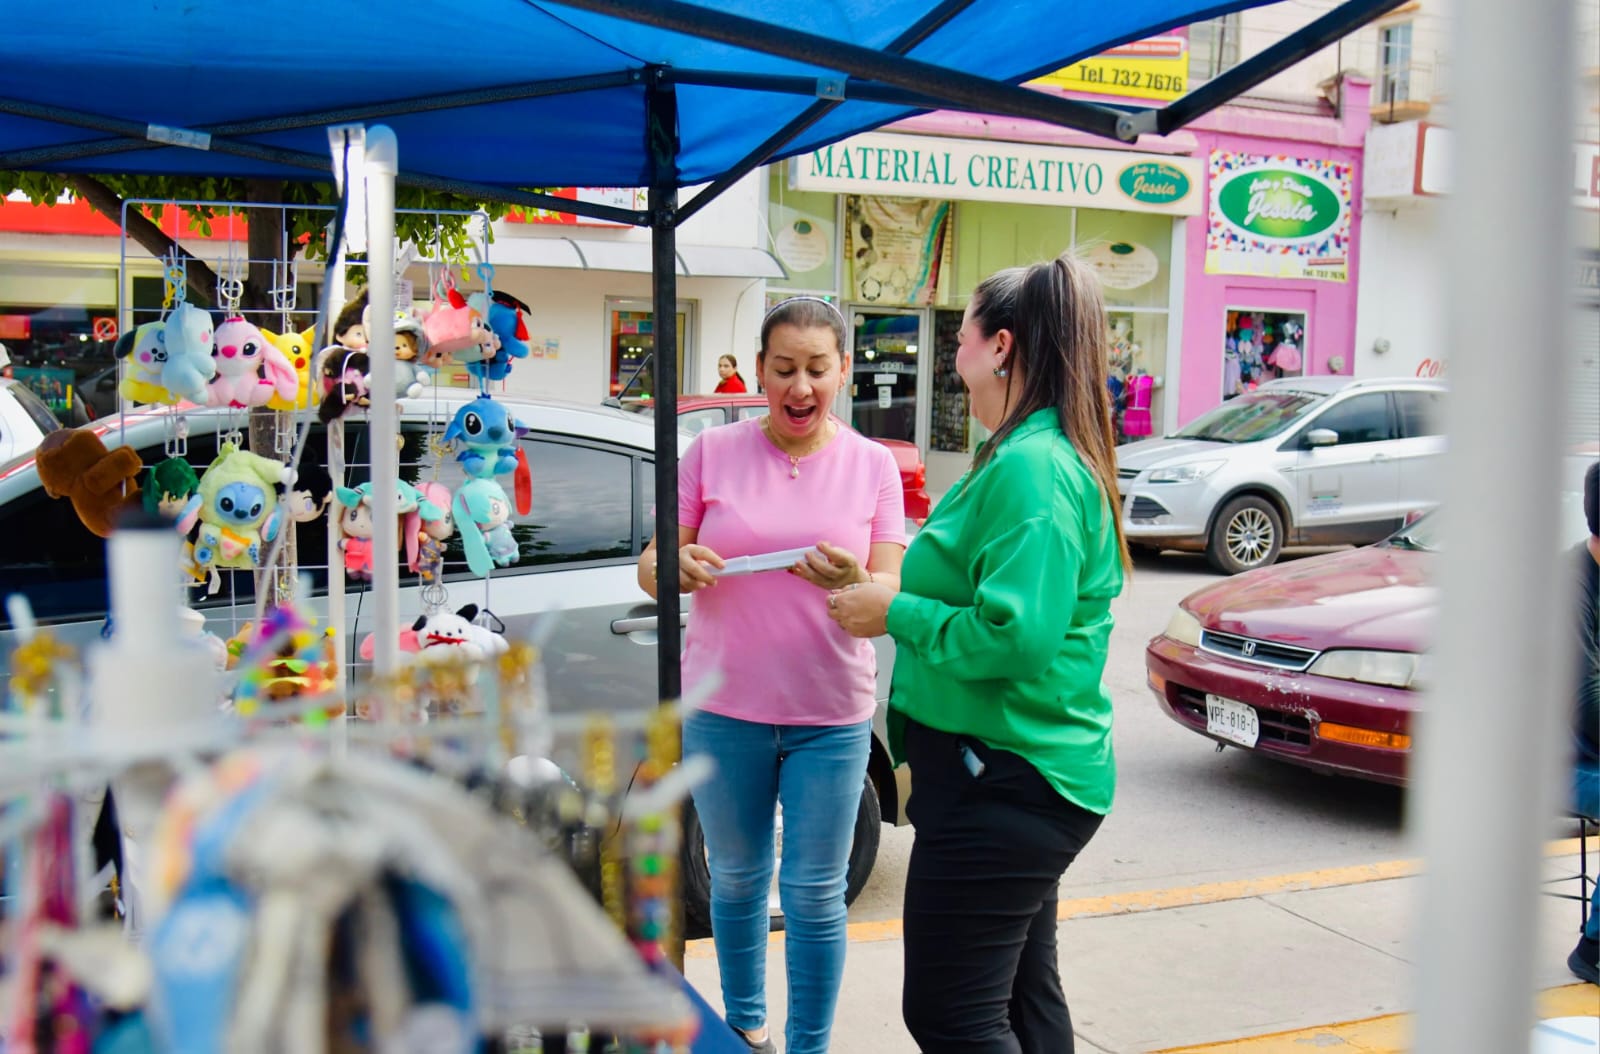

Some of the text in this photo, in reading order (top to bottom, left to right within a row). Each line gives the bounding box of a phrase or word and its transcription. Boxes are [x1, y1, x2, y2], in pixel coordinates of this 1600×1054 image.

[1111, 68, 1141, 88] 732
[1145, 72, 1183, 92] 7676
[810, 145, 1103, 195] MATERIAL CREATIVO
[1208, 704, 1257, 736] VPE-818-C
